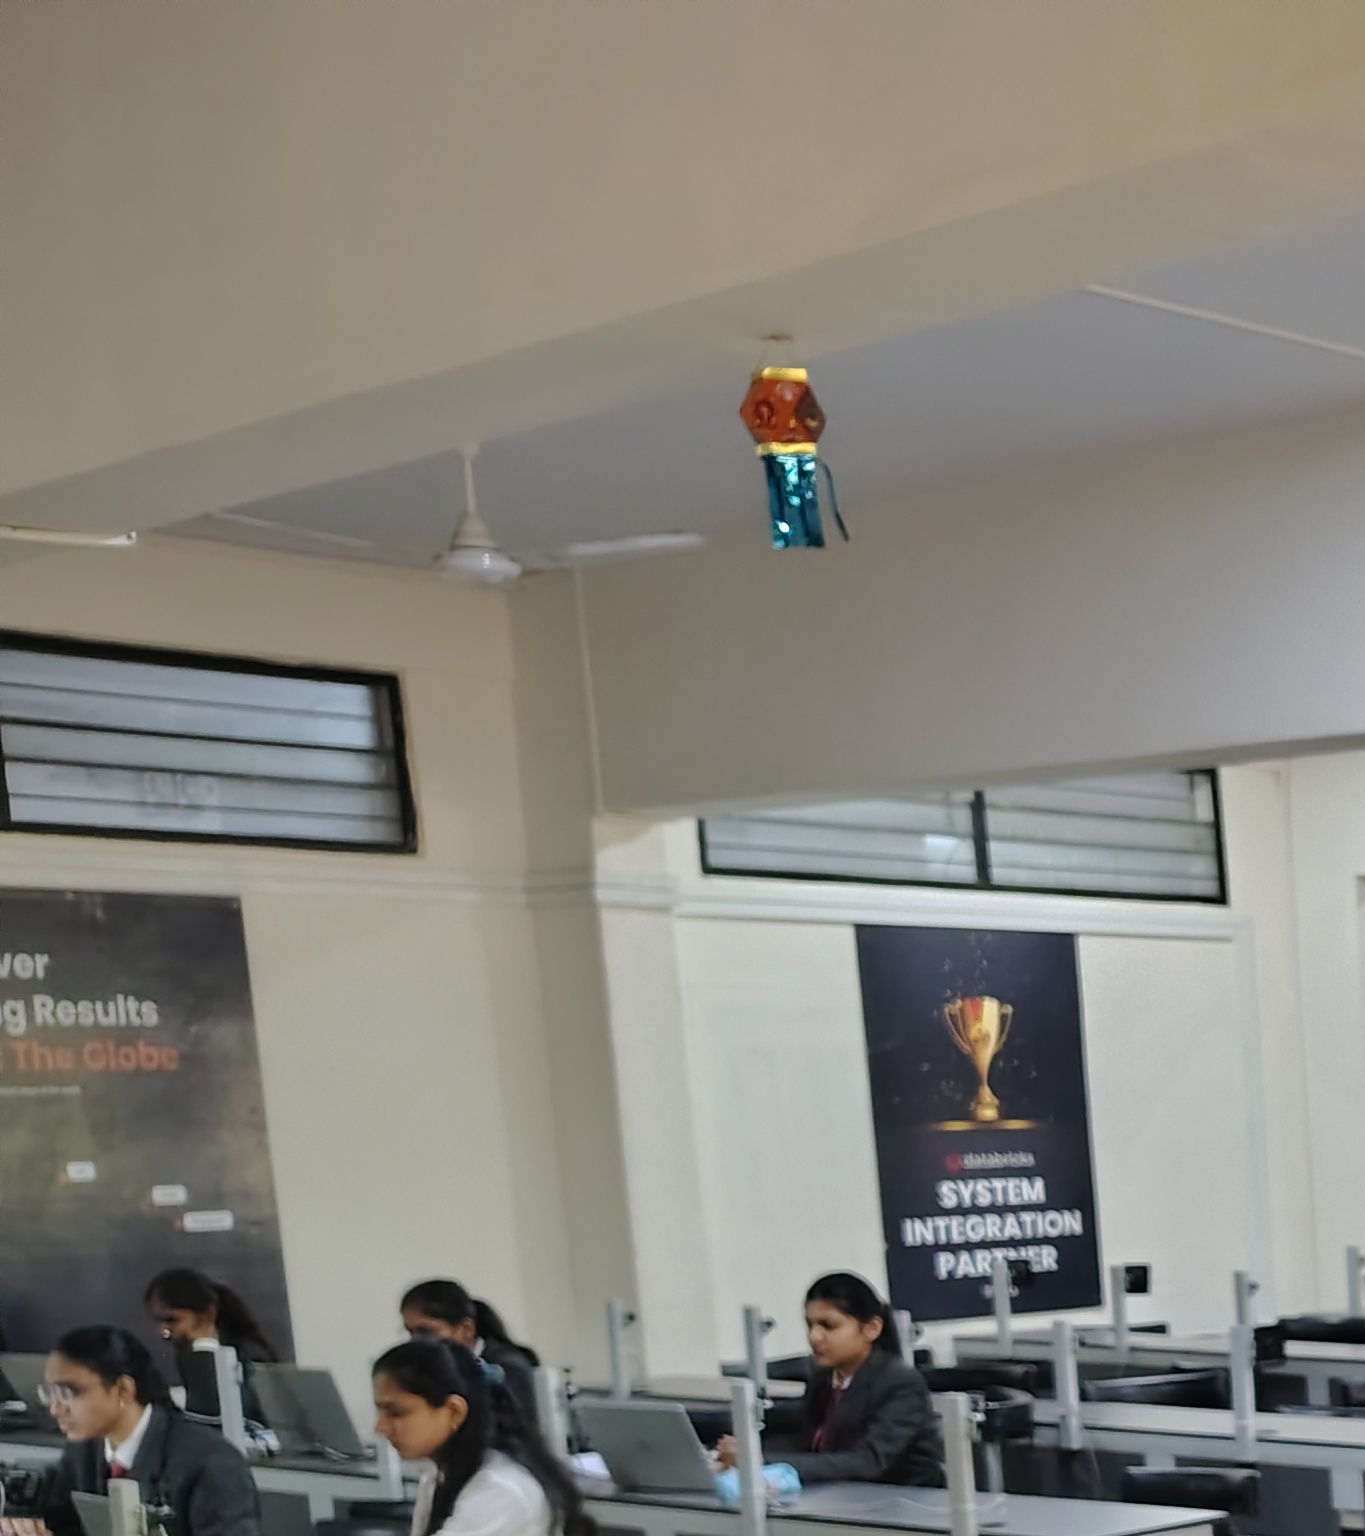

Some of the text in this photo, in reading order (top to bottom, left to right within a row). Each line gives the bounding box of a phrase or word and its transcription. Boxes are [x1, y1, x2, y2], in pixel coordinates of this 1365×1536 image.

[32, 993, 159, 1027] Results
[11, 1039, 178, 1071] The Globe
[937, 1176, 1046, 1208] SYSTEM
[903, 1209, 1083, 1248] INTEGRATION
